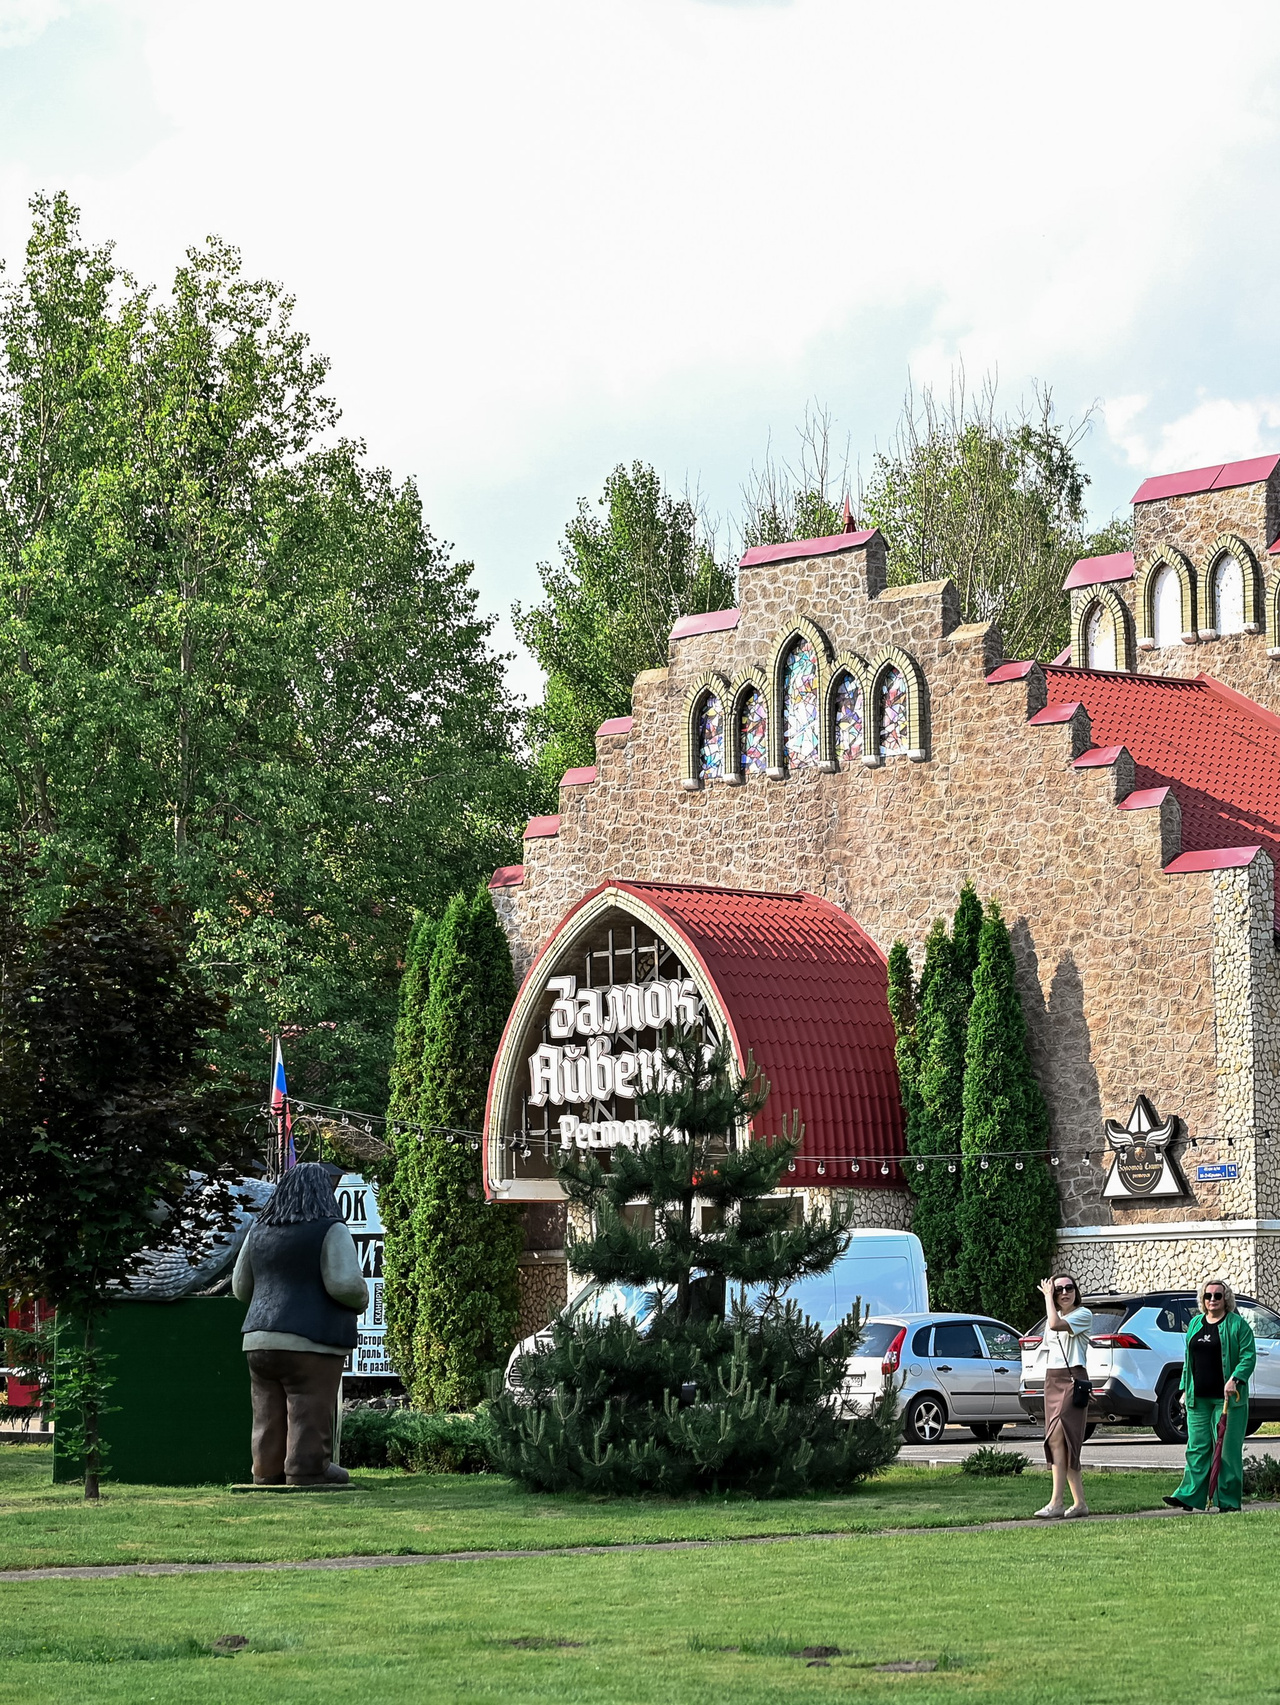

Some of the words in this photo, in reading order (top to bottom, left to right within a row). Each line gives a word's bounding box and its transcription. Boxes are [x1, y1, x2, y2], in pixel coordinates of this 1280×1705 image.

[545, 975, 702, 1038] Замок
[357, 1333, 384, 1347] Остор
[358, 1347, 381, 1360] Троль
[358, 1360, 367, 1372] Не
[370, 1360, 394, 1373] разбу
